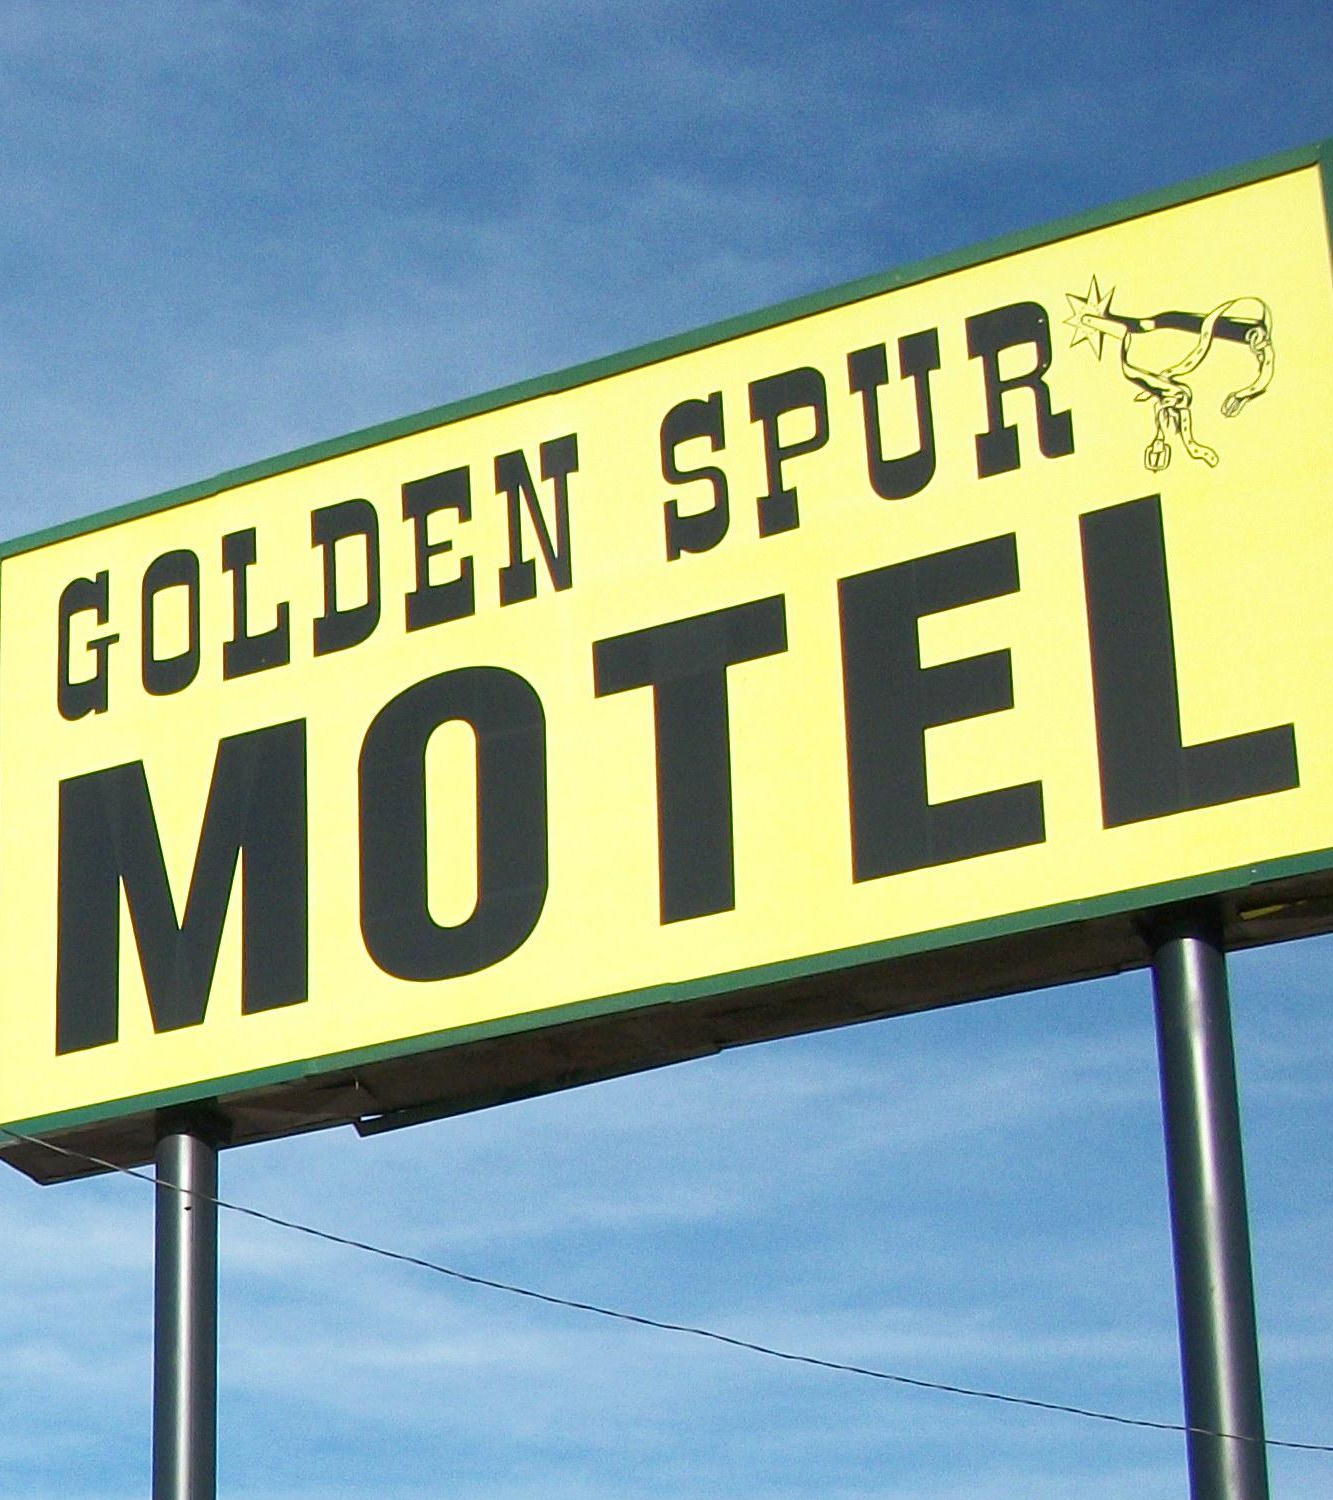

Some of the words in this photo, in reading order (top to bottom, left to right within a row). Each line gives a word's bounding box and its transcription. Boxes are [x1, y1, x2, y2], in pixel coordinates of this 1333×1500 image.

[57, 432, 579, 721] GOLDEN
[659, 301, 1075, 561] SPUR
[55, 493, 1301, 1056] MOTEL
